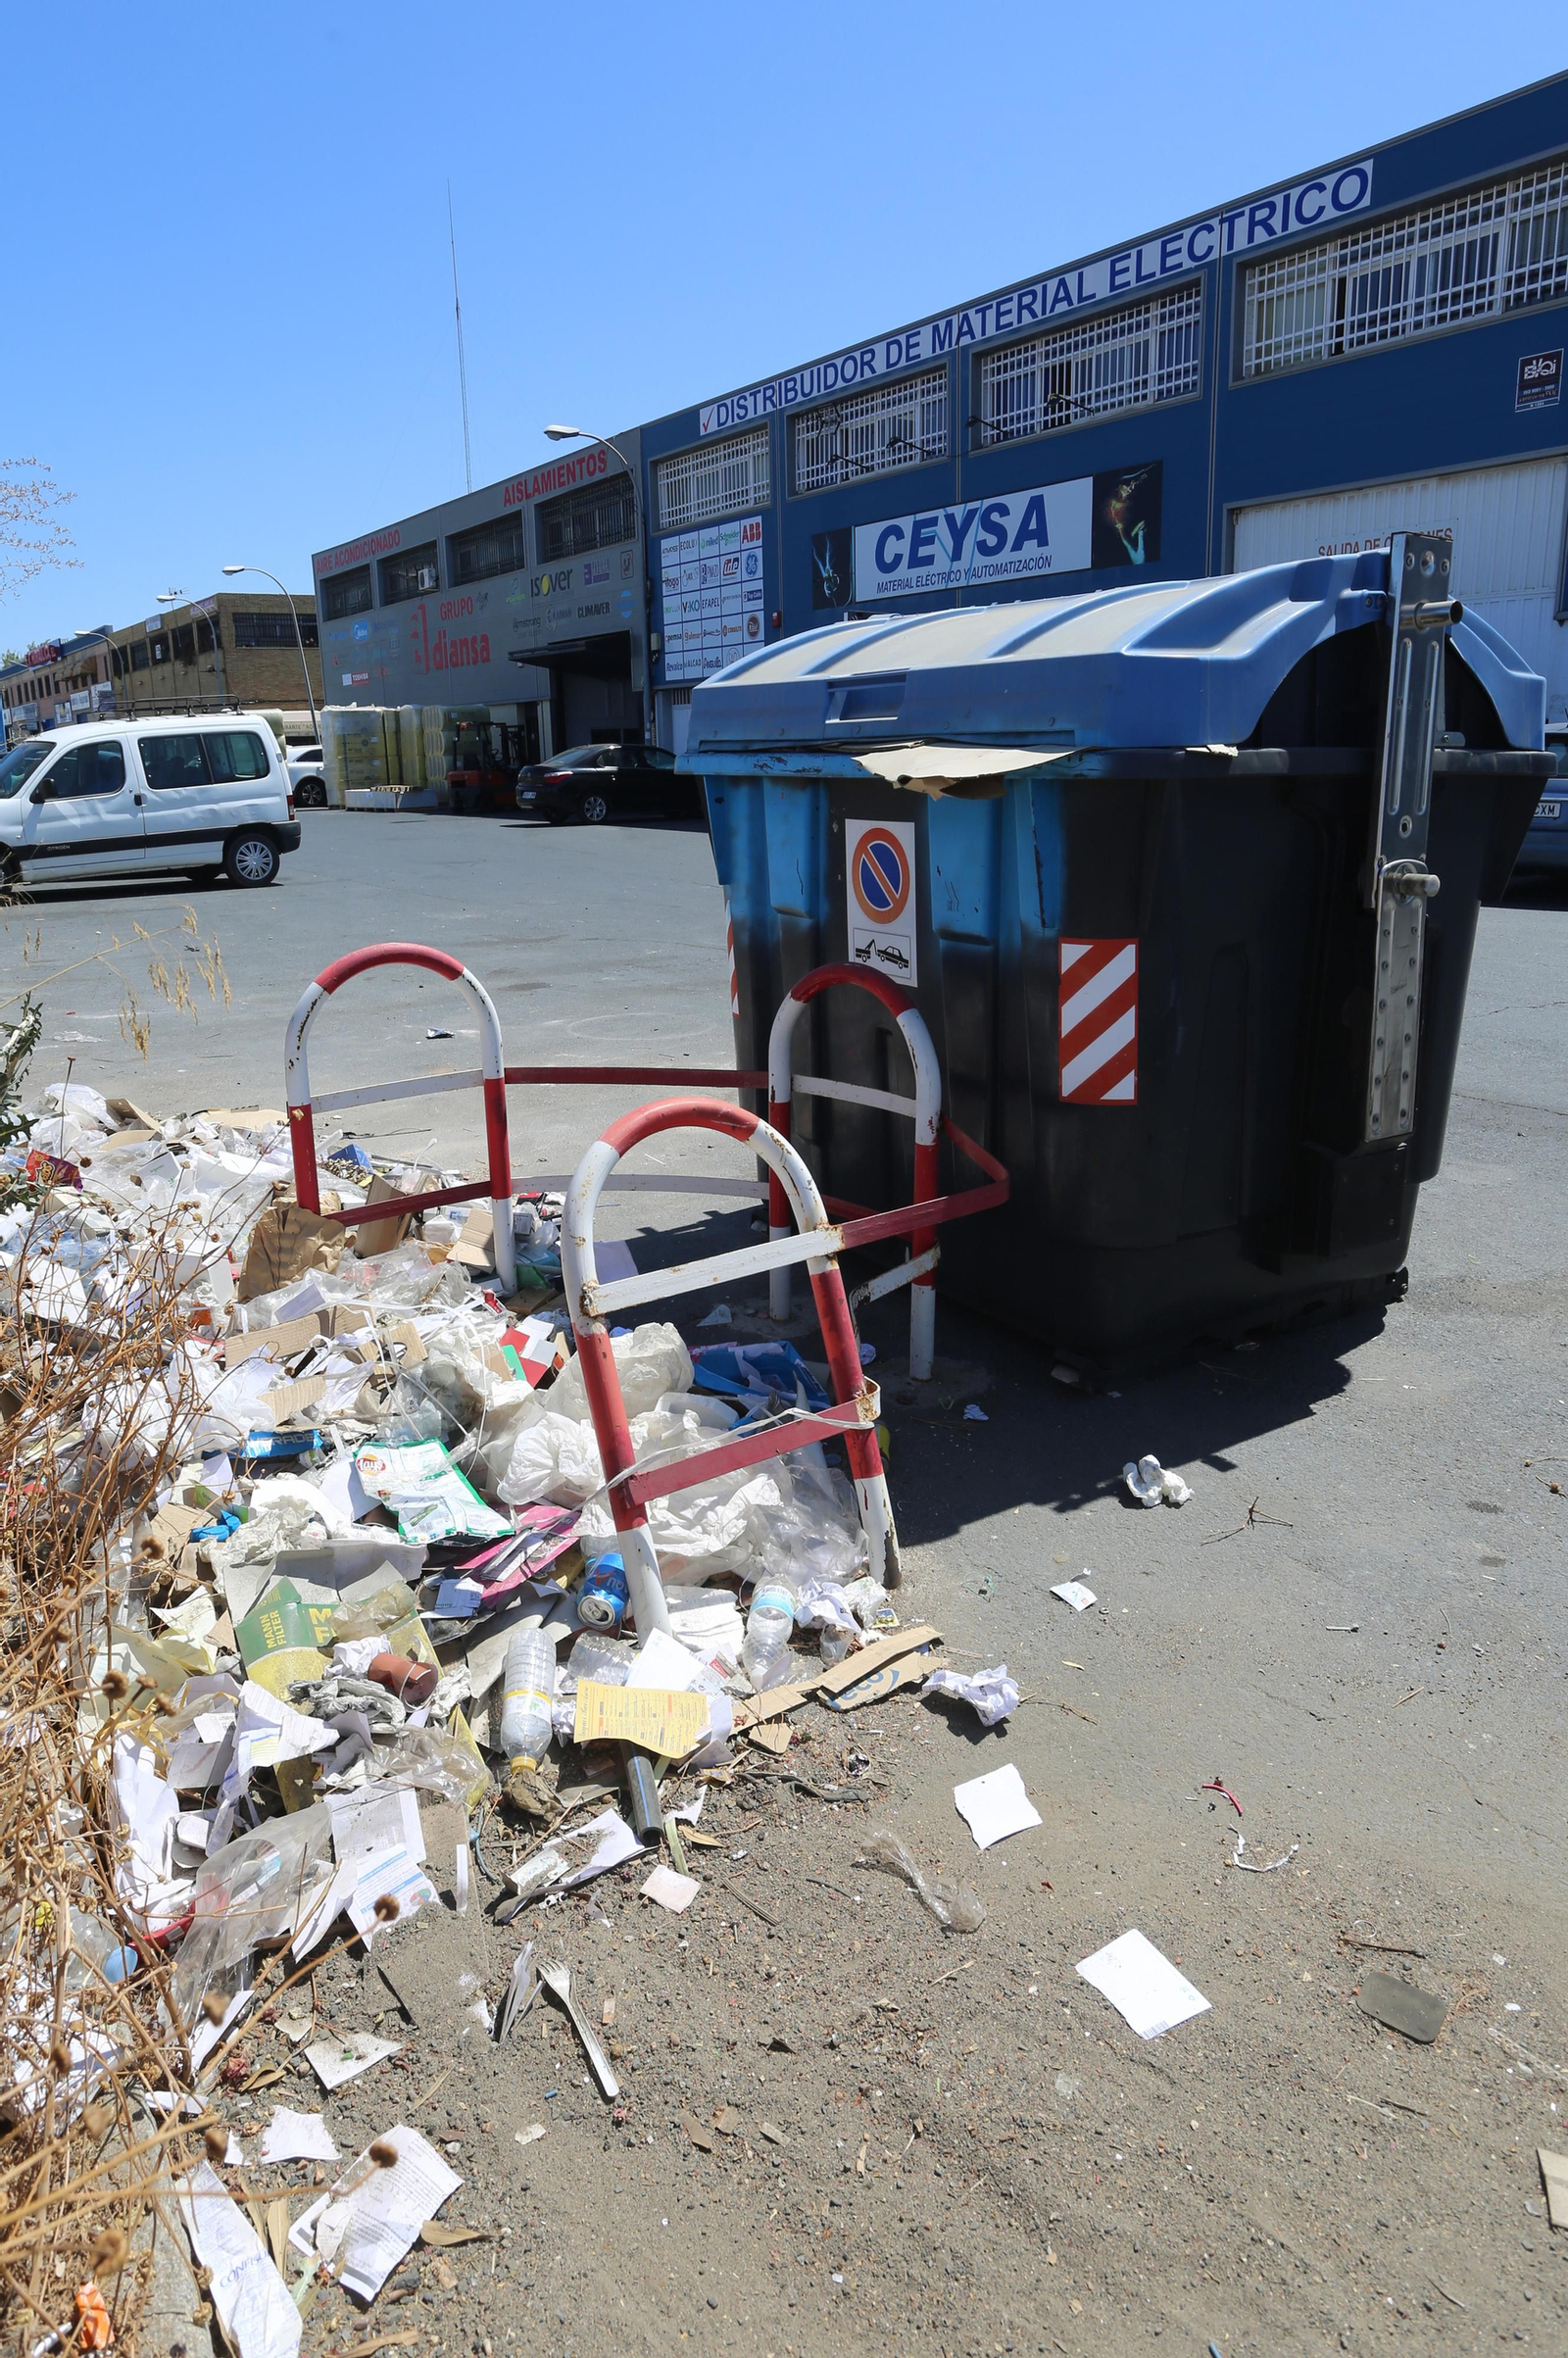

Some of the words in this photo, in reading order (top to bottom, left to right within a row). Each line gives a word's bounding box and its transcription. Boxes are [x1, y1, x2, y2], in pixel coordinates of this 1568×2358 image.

[716, 347, 877, 429] DISTRIBUIDOR
[885, 331, 921, 369] DE
[931, 270, 1097, 357] MATERIAL
[1108, 167, 1370, 294] ELECTRICO
[503, 449, 608, 508] AISLAMIENTOS
[317, 554, 333, 574] AIRE
[334, 528, 401, 568] ACONDICIONADO
[741, 521, 761, 544] ABB
[874, 494, 1051, 574] CEYSA
[876, 578, 915, 594] MATERIAL
[915, 569, 961, 588] ELÉCTRICO
[961, 567, 970, 581] Y
[970, 553, 1053, 580] AUTOMATIZACIÓN
[440, 596, 473, 621] GRUPO
[577, 602, 611, 618] CLIMAVER
[702, 597, 720, 610] EFAPEL
[259, 1613, 277, 1649] MANN
[270, 1608, 287, 1646] FILTER
